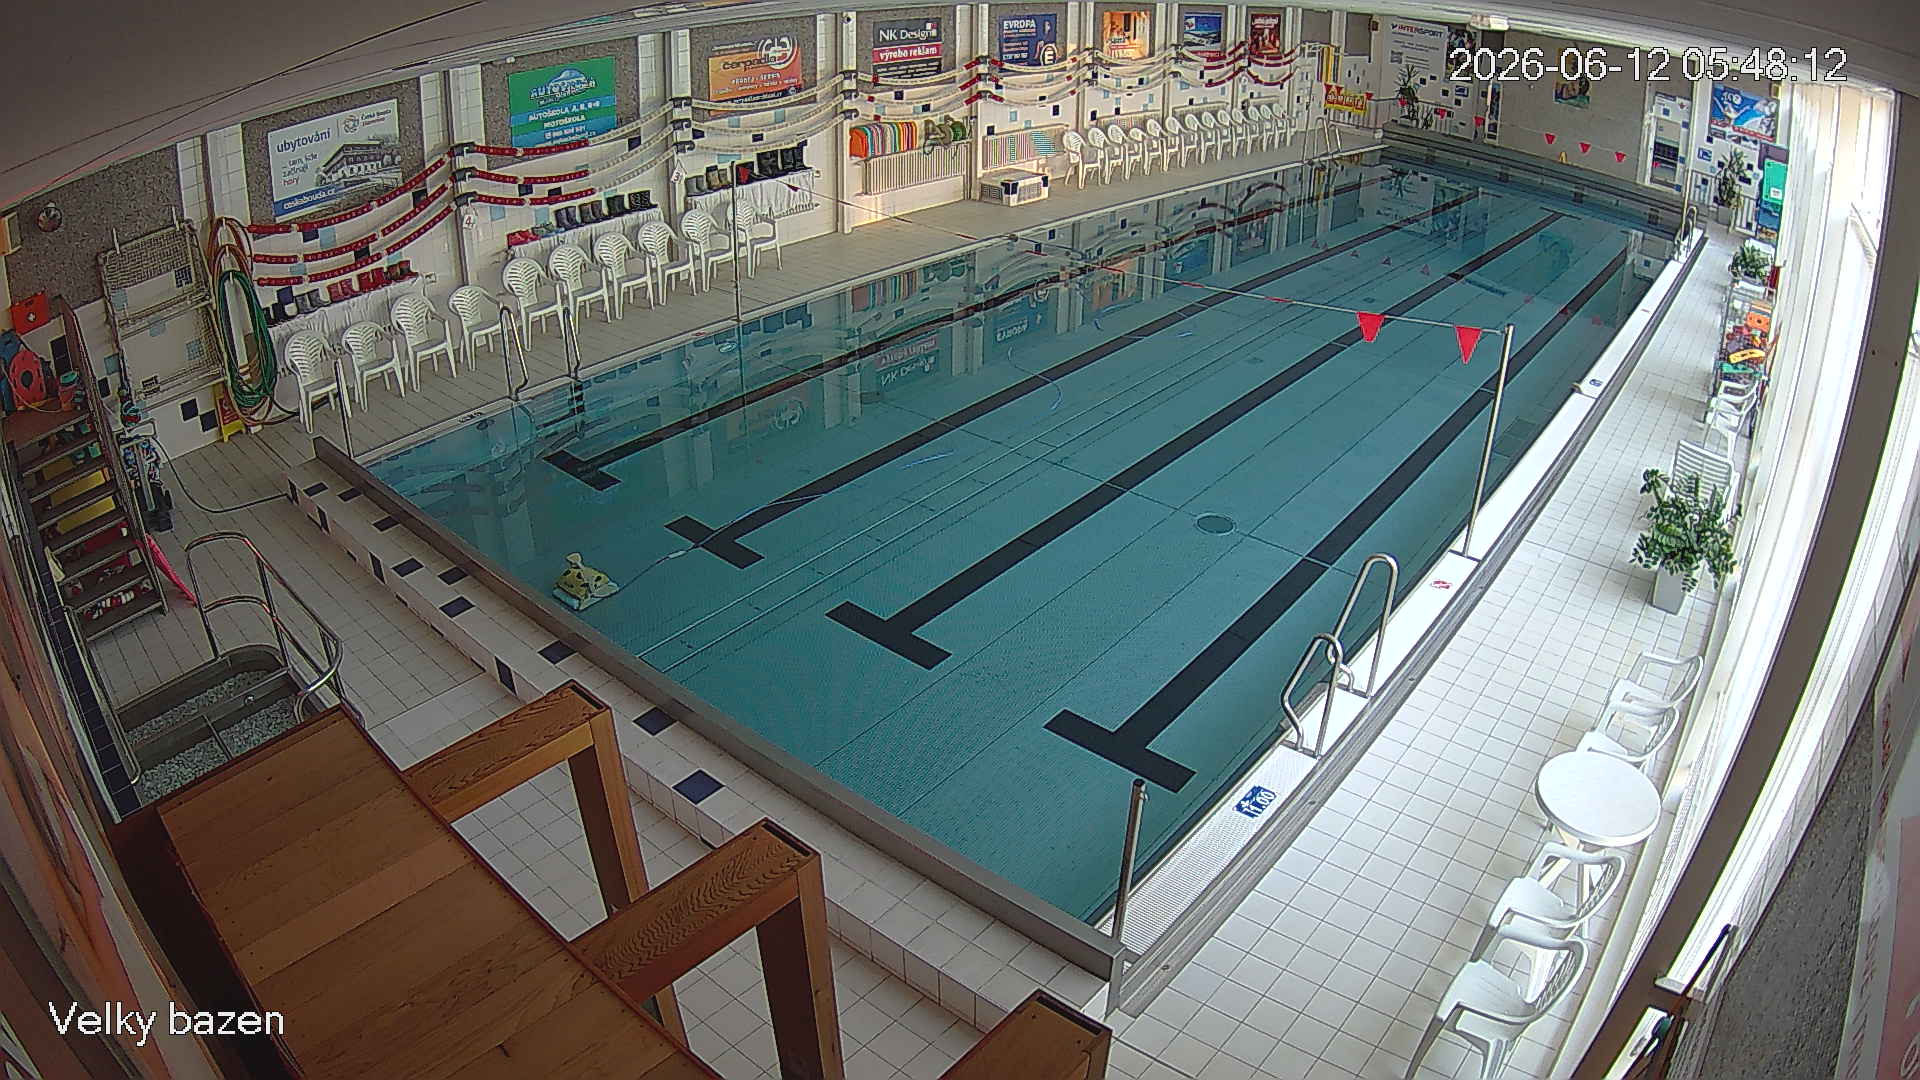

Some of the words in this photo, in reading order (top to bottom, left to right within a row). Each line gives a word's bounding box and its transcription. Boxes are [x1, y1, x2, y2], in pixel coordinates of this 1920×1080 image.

[1003, 19, 1036, 30] EVROPA
[1398, 24, 1443, 38] INTERSPORT
[879, 29, 897, 41] NK
[900, 29, 932, 41] Design
[879, 48, 909, 62] výroba
[909, 46, 937, 57] reklam
[276, 127, 331, 153] ubytování
